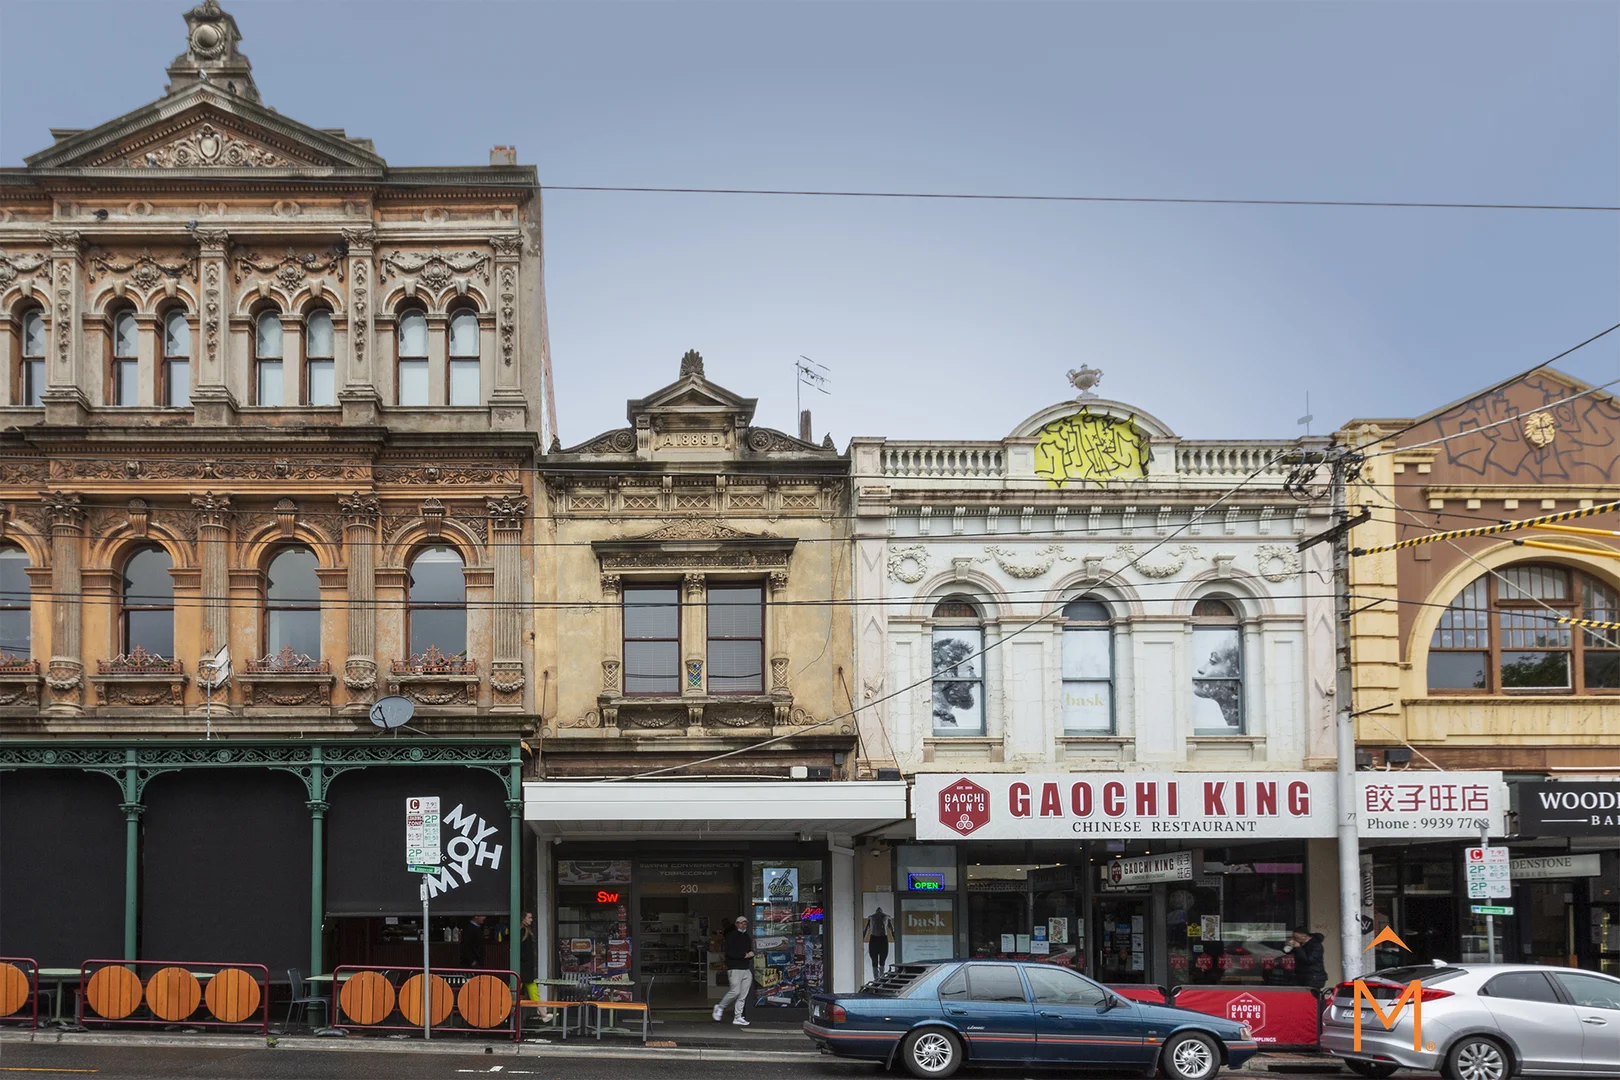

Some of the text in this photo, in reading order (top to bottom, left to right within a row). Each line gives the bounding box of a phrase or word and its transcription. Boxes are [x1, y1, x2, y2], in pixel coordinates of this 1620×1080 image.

[1065, 693, 1104, 706] bask
[944, 793, 985, 803] GAOCHI
[1008, 781, 1311, 818] GAOCHI KING
[1365, 784, 1489, 812] 餃子旺店
[1538, 791, 1620, 810] WOOD
[944, 803, 985, 812] KING
[424, 815, 438, 823] 2P
[443, 803, 499, 845] MY
[1367, 818, 1410, 829] Phone
[1420, 818, 1454, 829] 9939
[1072, 821, 1258, 833] CHINESE RESTAURANT
[408, 849, 423, 857] 2P
[1124, 860, 1152, 875] GAOCHI
[1154, 858, 1174, 872] KING
[1469, 865, 1486, 874] 2P
[1509, 857, 1572, 870] DENSTONE
[680, 884, 698, 893] 230
[1470, 882, 1487, 891] 2P
[597, 890, 619, 903] Sw
[907, 914, 945, 927] bask
